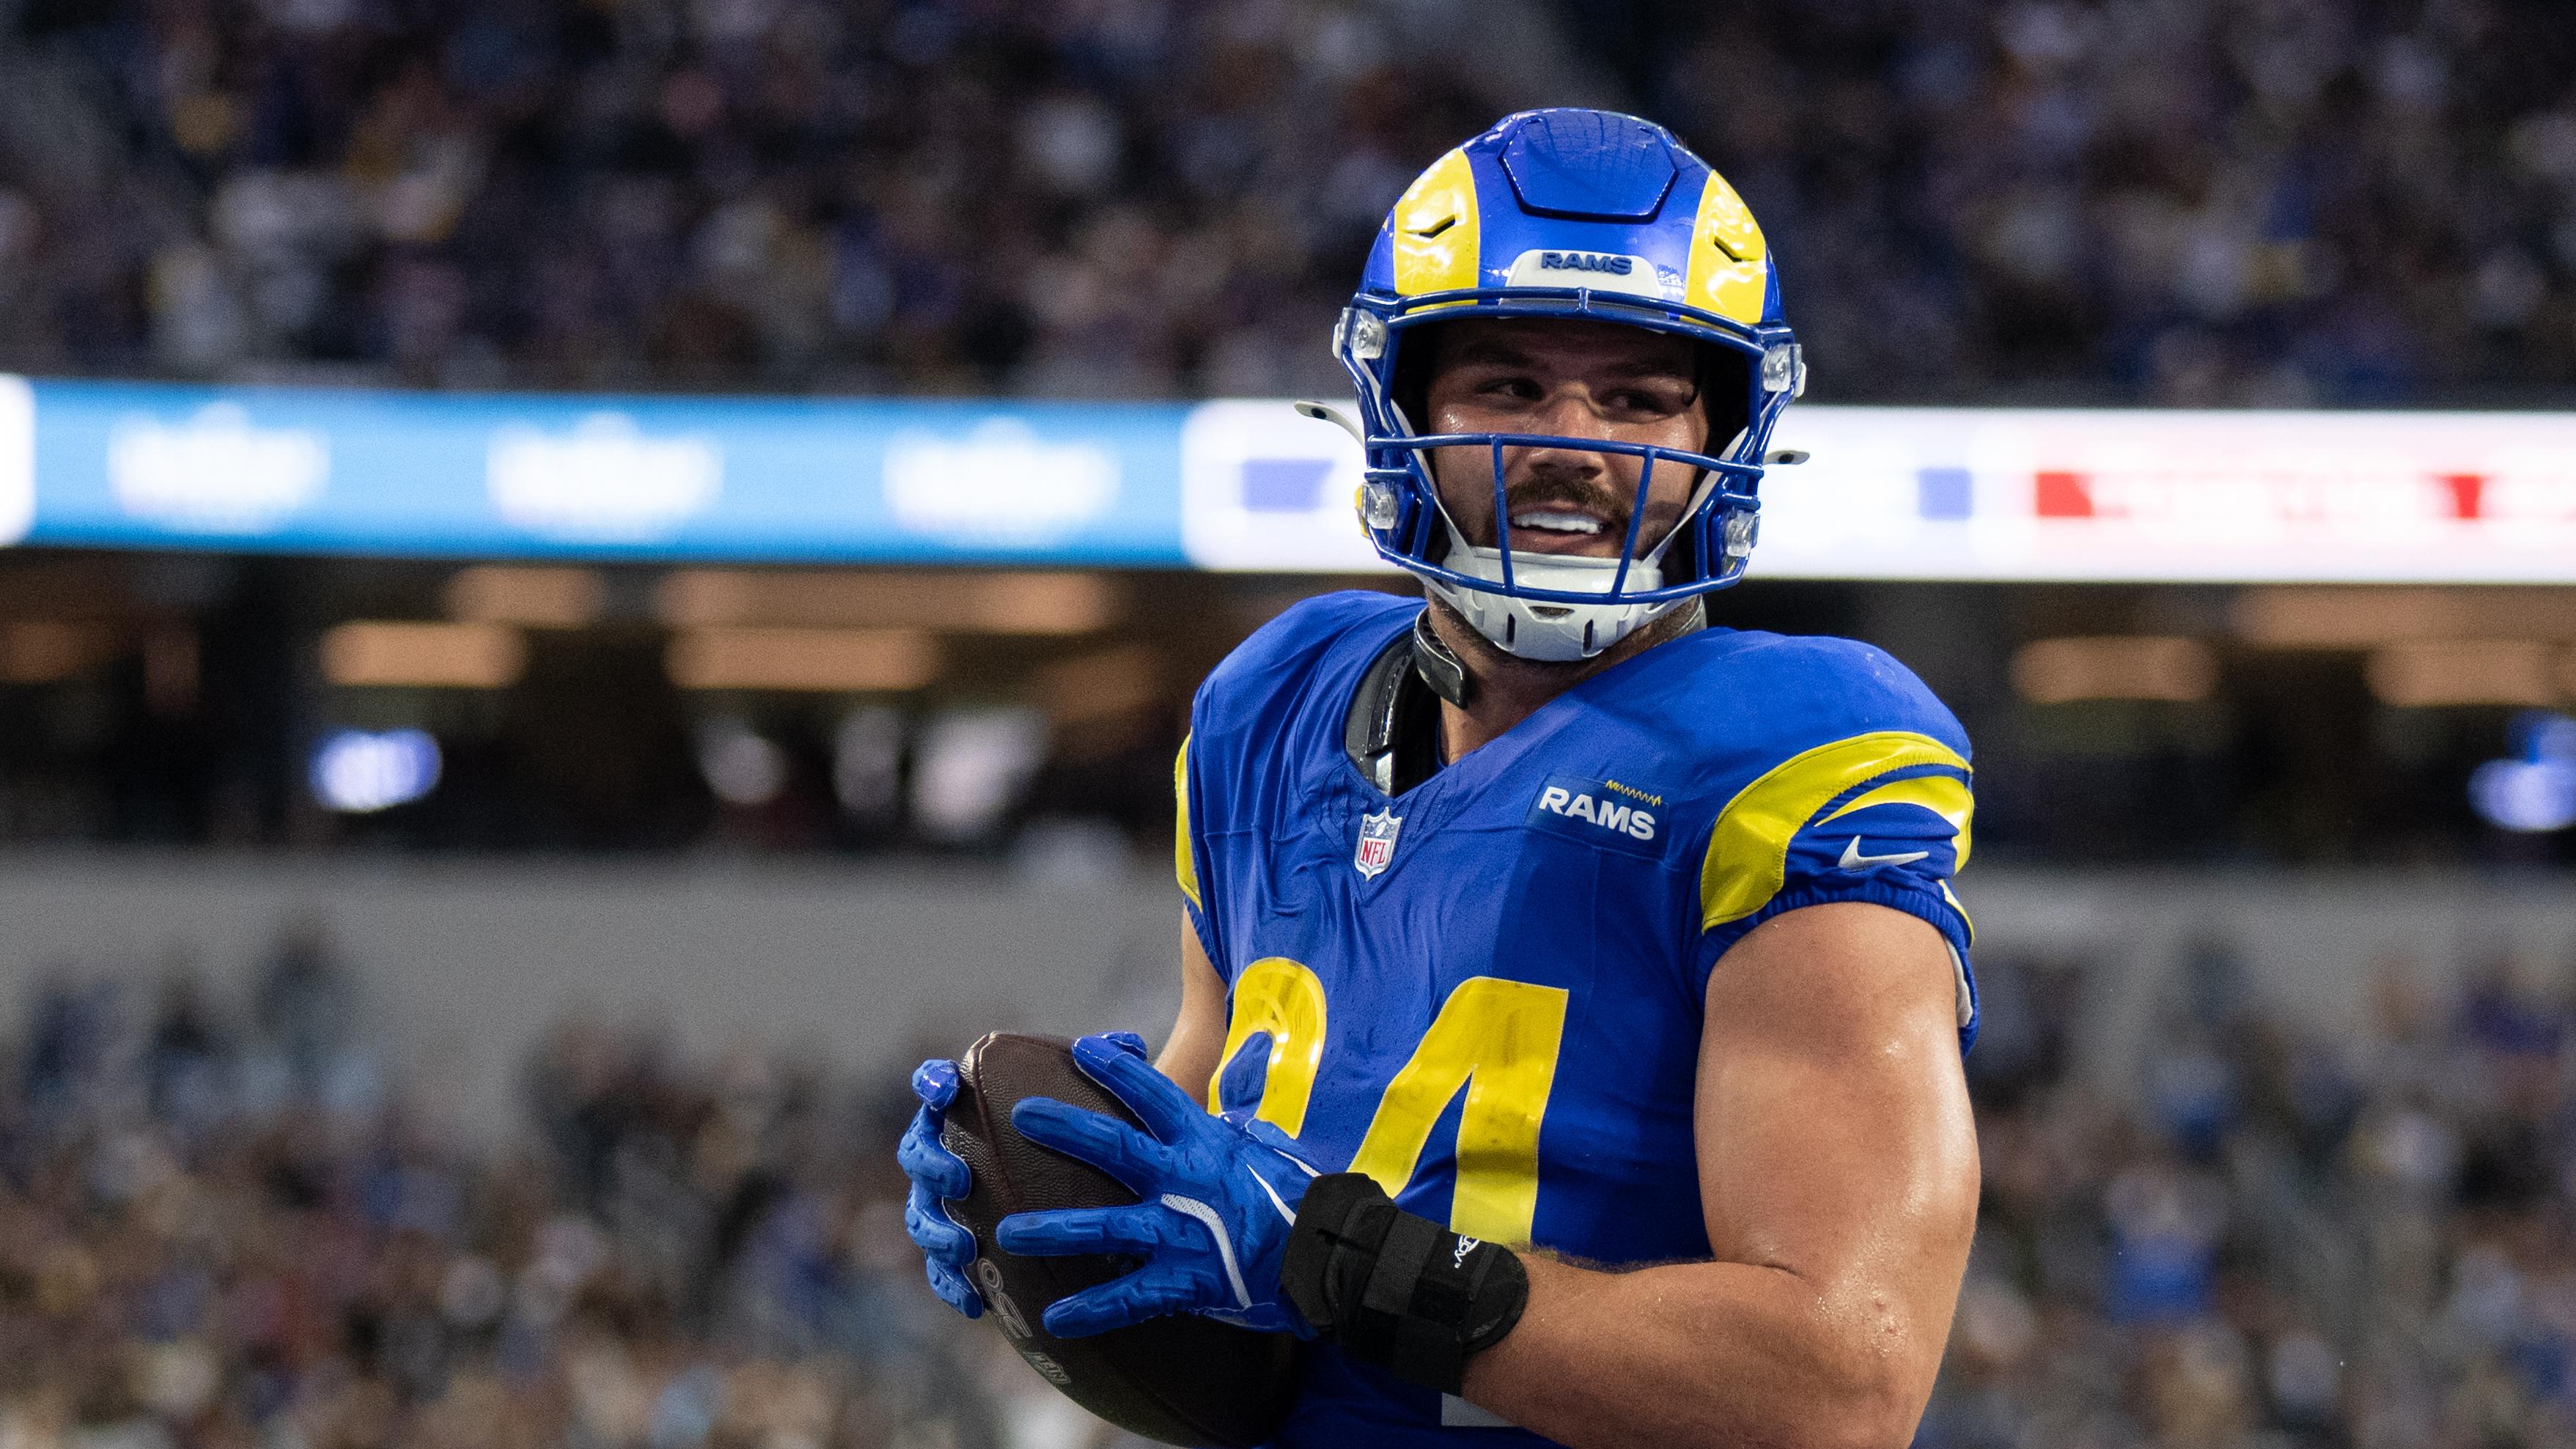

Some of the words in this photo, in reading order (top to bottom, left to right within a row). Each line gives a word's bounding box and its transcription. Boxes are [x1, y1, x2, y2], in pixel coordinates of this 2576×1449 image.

[1541, 252, 1632, 276] RAMS
[1539, 786, 1656, 841] RAMS
[1360, 839, 1386, 866] NFL
